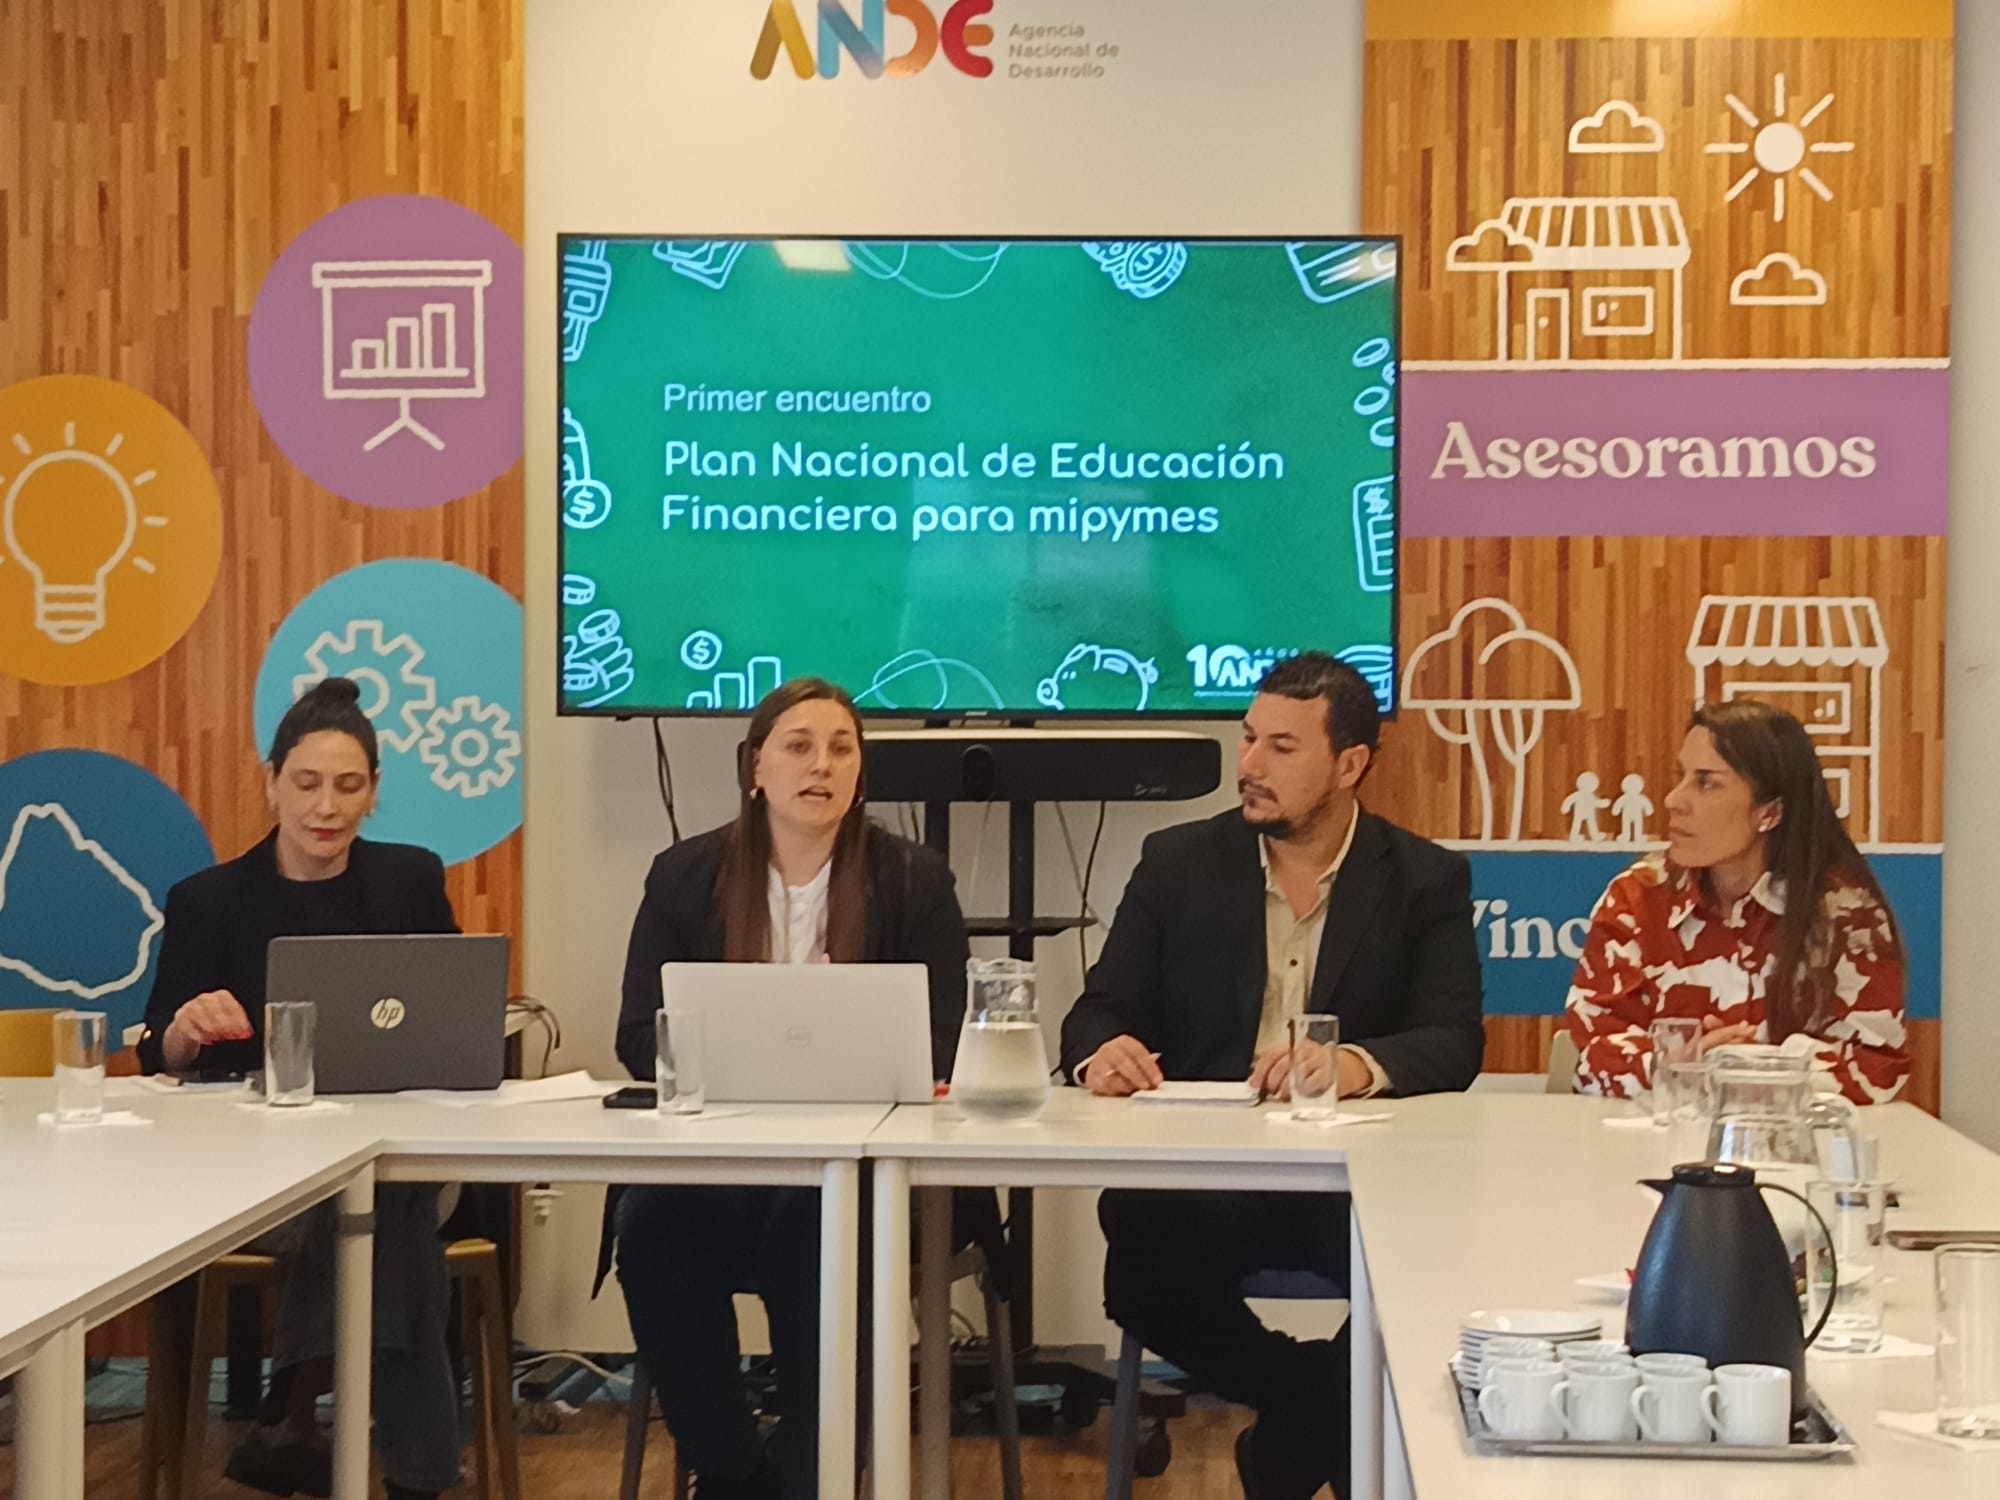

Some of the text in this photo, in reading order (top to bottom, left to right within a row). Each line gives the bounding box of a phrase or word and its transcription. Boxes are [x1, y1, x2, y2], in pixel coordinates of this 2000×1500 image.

[750, 0, 994, 81] ANDE
[1008, 23, 1085, 40] Agencia
[1008, 42, 1120, 58] Nacional de
[1008, 63, 1105, 79] Desarrollo
[664, 383, 931, 413] Primer encuentro
[665, 440, 1284, 479] Plan Nacional de Educación
[1430, 421, 1876, 479] Asesoramos
[662, 494, 1219, 543] Financiera para mipymes
[375, 998, 401, 1028] hp
